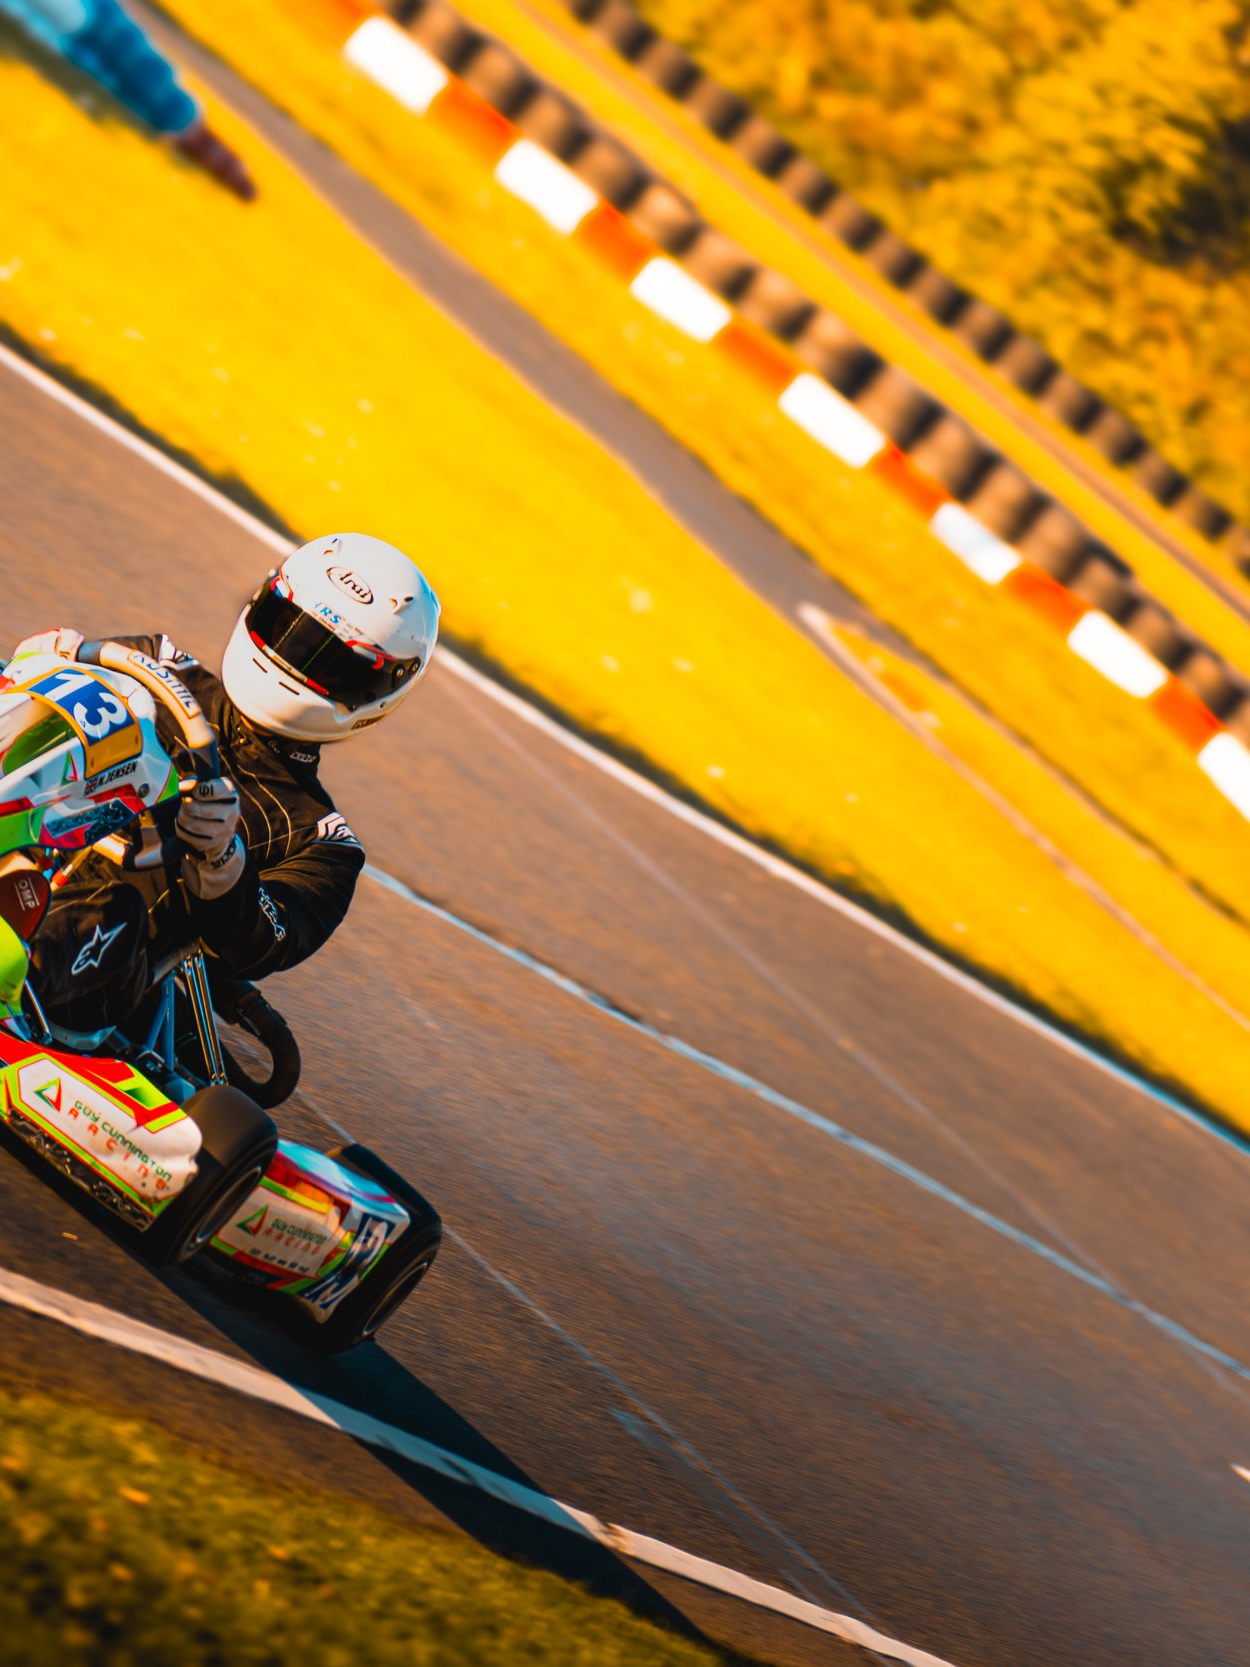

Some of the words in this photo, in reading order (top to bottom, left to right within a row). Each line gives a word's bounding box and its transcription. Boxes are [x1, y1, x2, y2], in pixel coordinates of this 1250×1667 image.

[43, 671, 128, 739] 13
[18, 879, 36, 909] OMP
[74, 1100, 102, 1122] GUY
